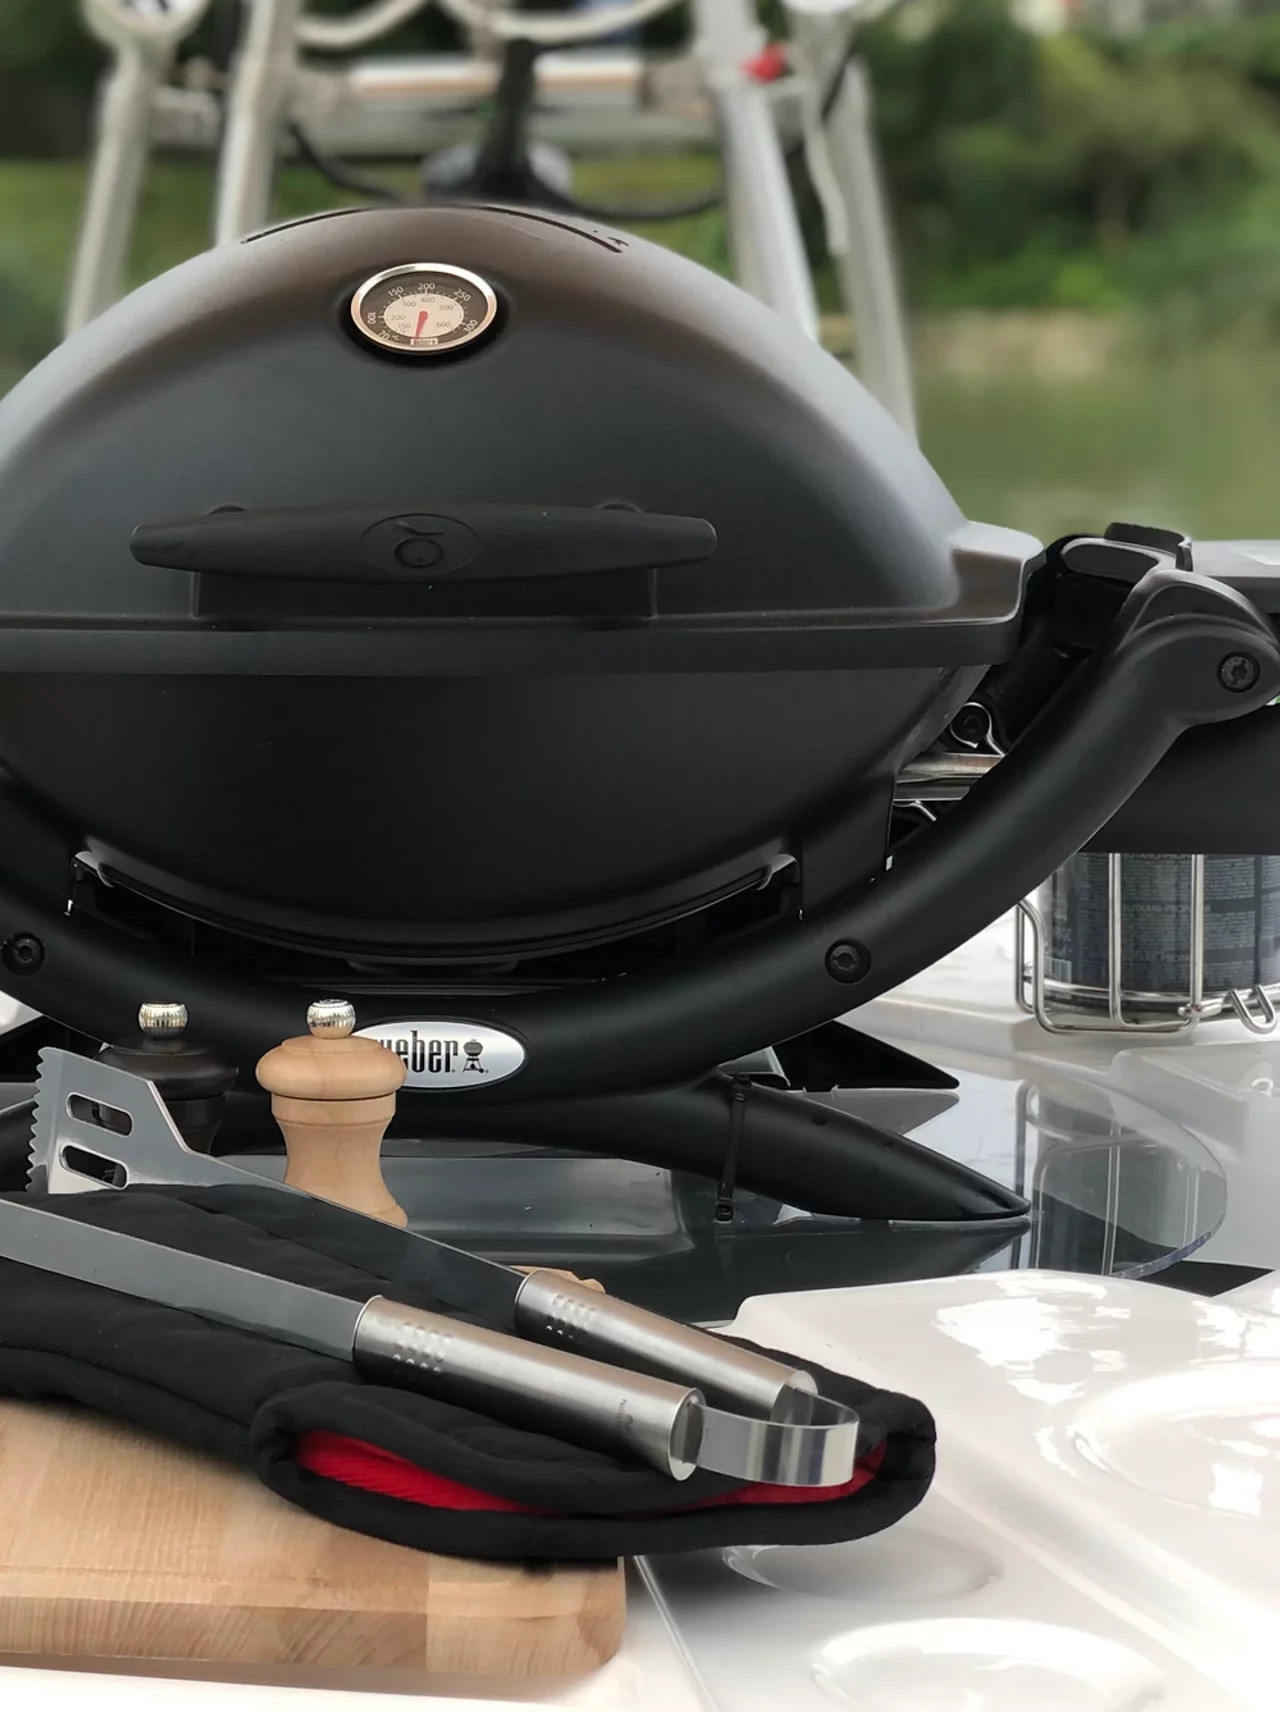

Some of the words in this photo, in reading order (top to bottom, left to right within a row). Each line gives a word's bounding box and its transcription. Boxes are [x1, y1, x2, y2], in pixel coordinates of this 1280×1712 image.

[388, 286, 403, 297] 150
[418, 282, 435, 290] 200
[453, 289, 471, 302] 250
[367, 312, 377, 325] 100
[379, 1030, 459, 1073] eber
